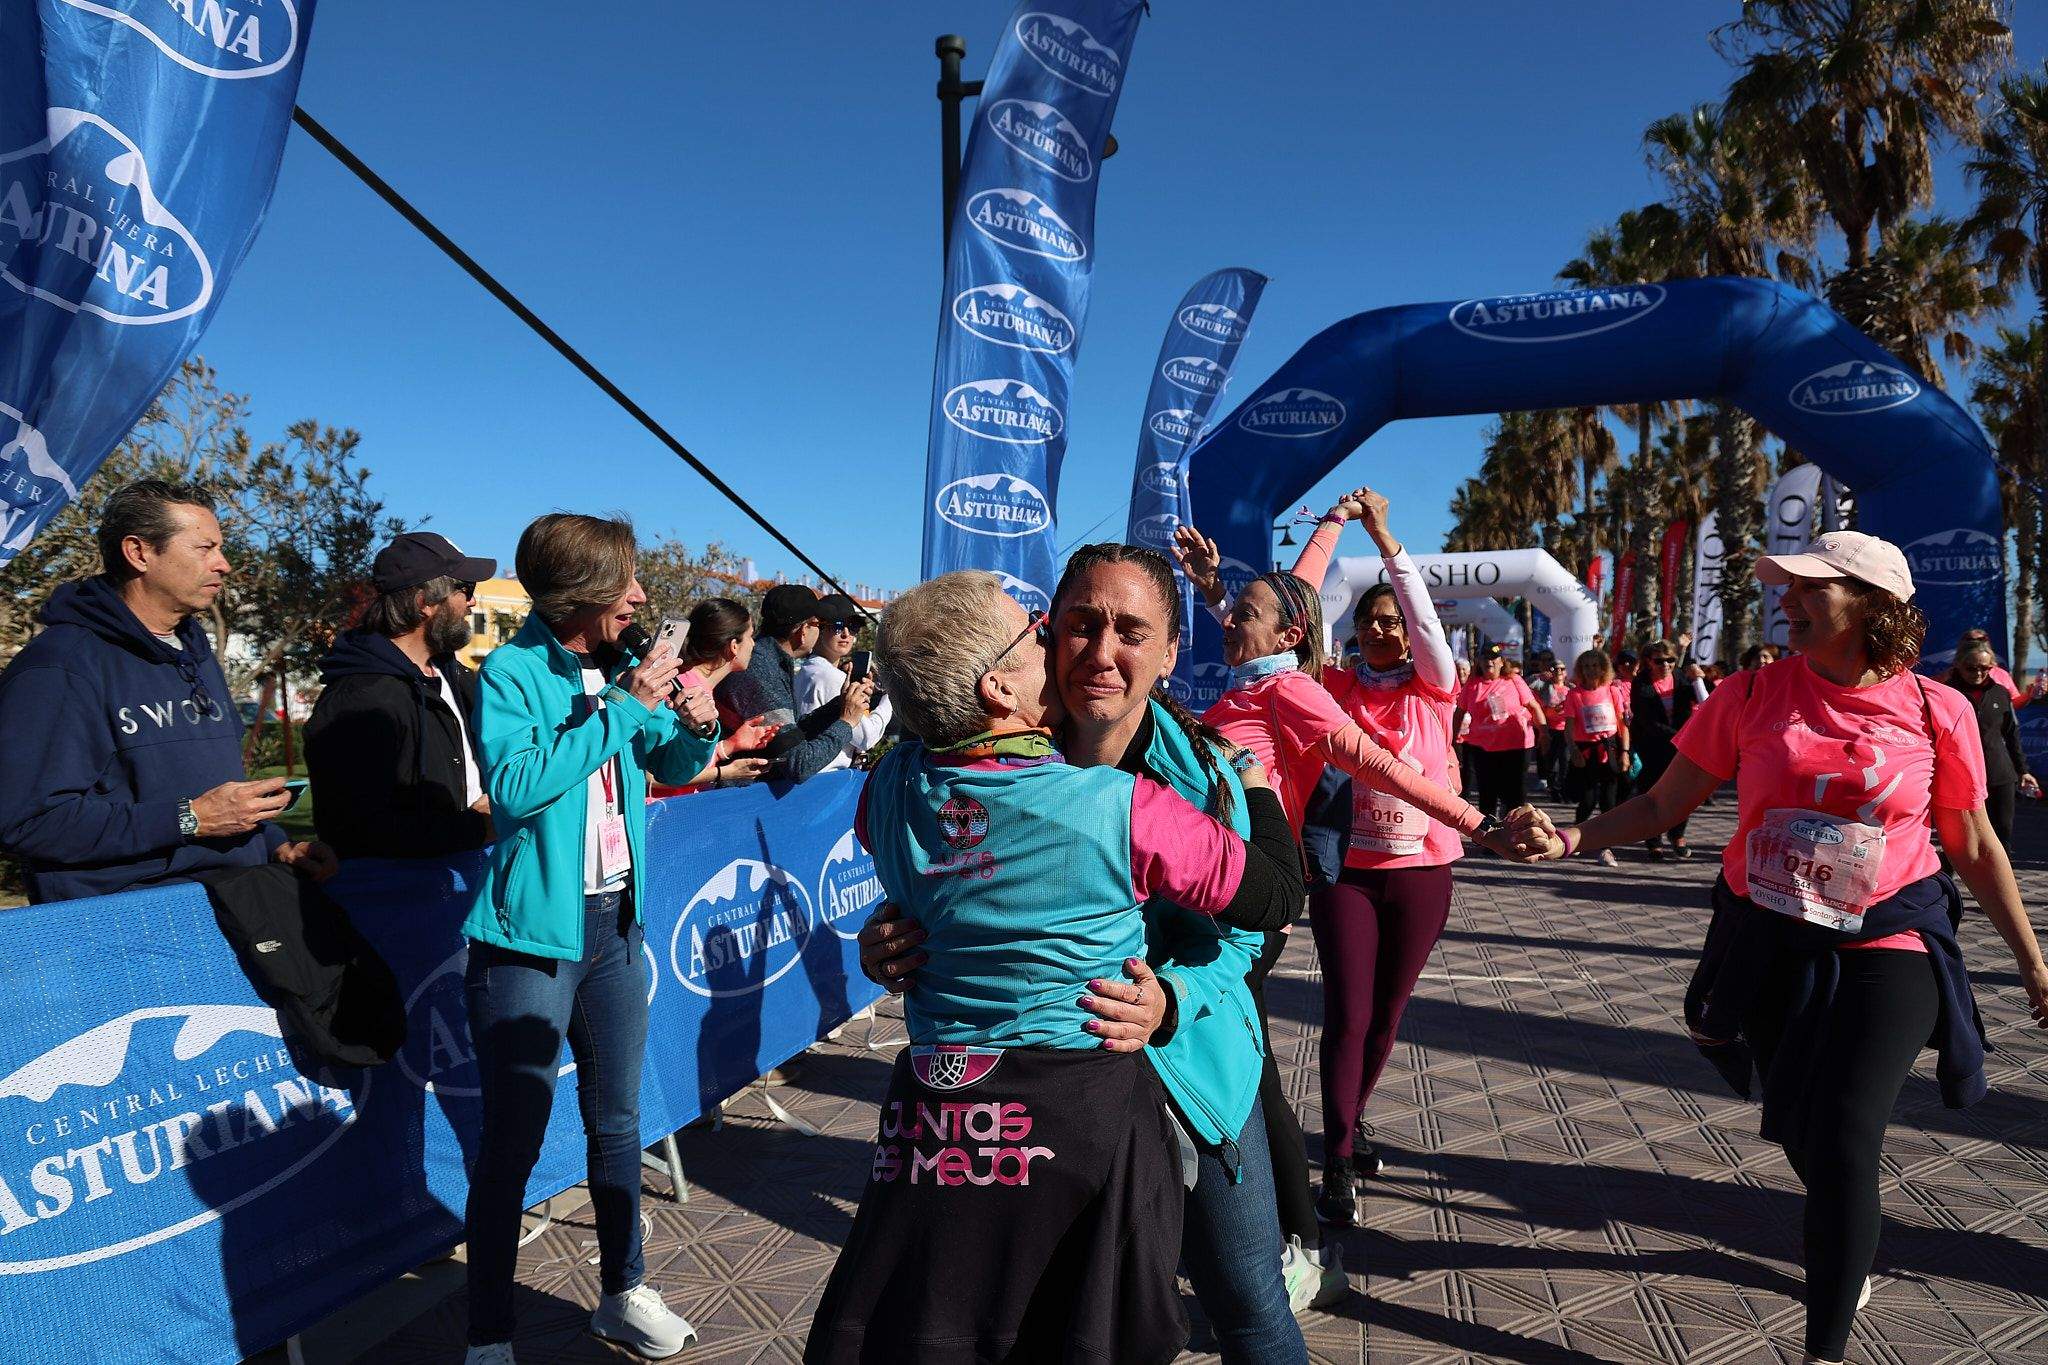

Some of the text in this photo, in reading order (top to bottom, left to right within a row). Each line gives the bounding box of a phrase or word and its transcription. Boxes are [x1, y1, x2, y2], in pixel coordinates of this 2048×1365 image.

[1023, 21, 1117, 93] ASTURIANA
[995, 107, 1083, 177] ASTURIANA
[975, 198, 1079, 256] ASTURIANA
[961, 298, 1063, 348] ASTURIANA
[1467, 291, 1651, 327] ASTURIANA
[1801, 381, 1914, 406] ASTURIANA
[1246, 410, 1338, 427] ASTURIANA
[1373, 809, 1404, 824] 016
[1783, 855, 1834, 882] 016
[708, 903, 756, 928] CENTRAL
[828, 875, 885, 922] ASTURIA
[689, 903, 808, 979] ASTURIANA
[26, 1047, 293, 1146] CENTRAL LECHE
